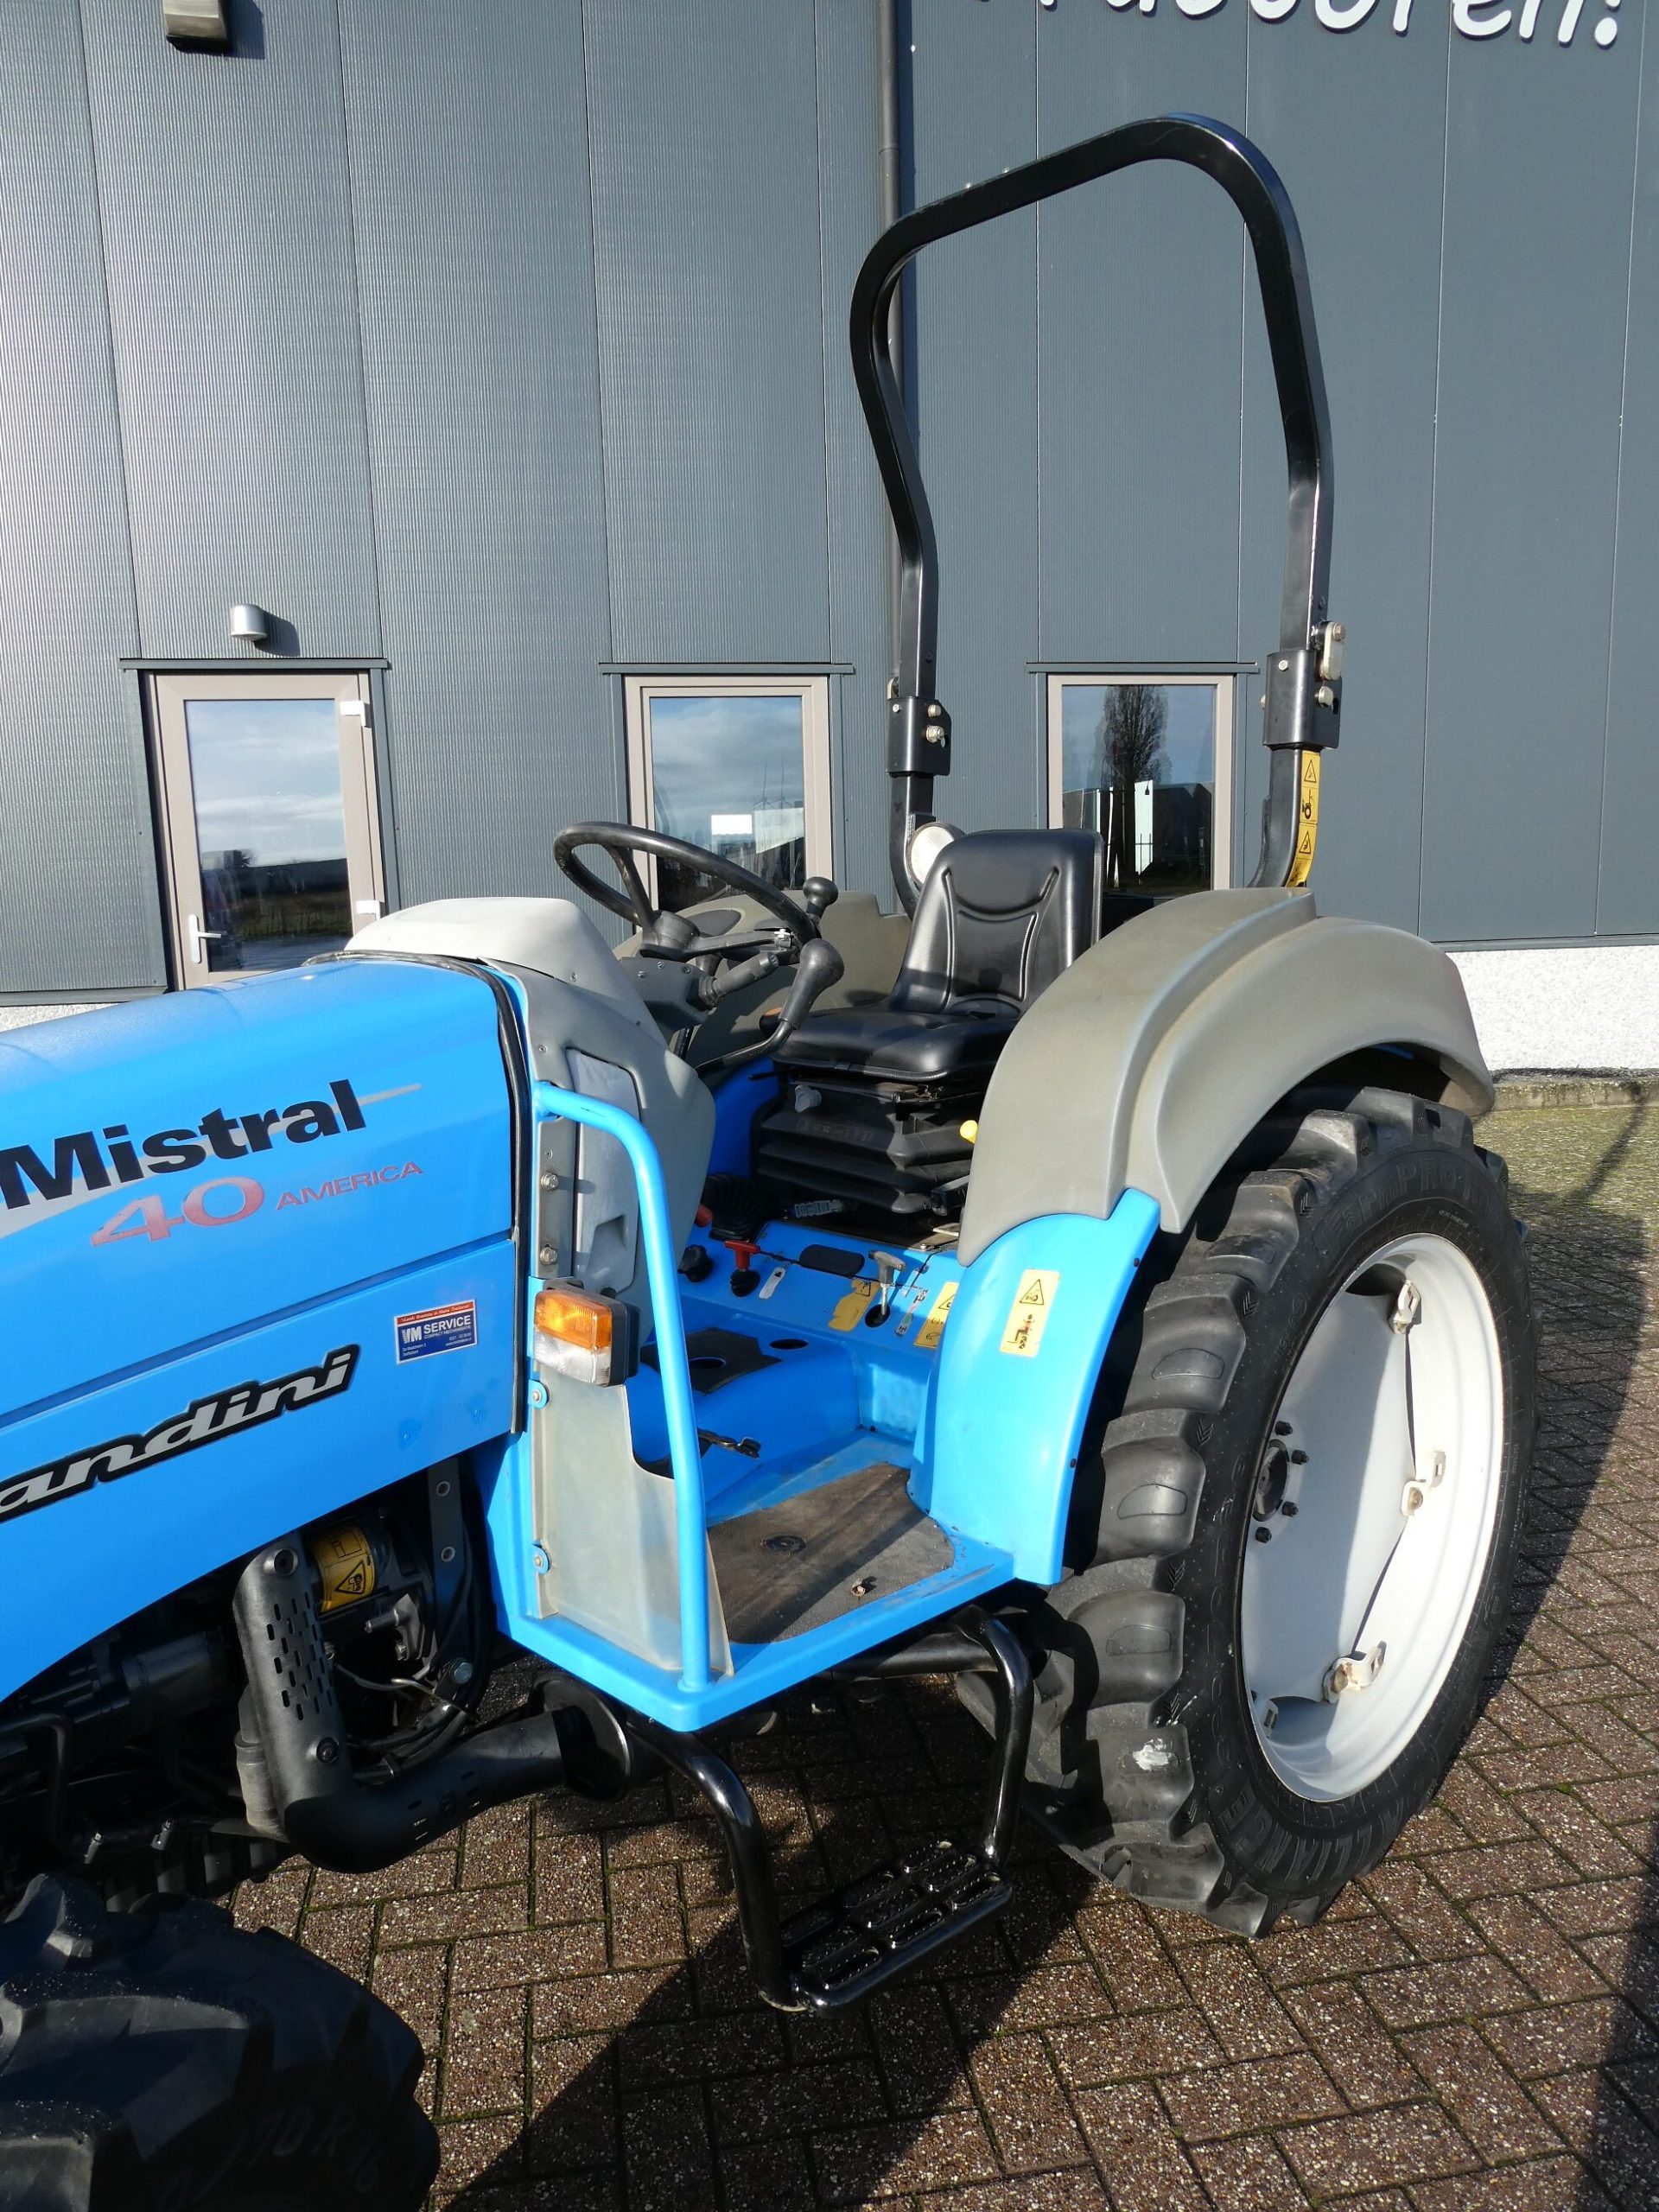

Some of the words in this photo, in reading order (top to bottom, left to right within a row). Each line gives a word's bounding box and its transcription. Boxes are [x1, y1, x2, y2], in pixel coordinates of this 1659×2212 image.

[0, 1079, 366, 1210] Mistral
[90, 1176, 265, 1247] 40
[276, 1160, 423, 1211] AMERICA
[423, 1315, 472, 1334] SERVICE
